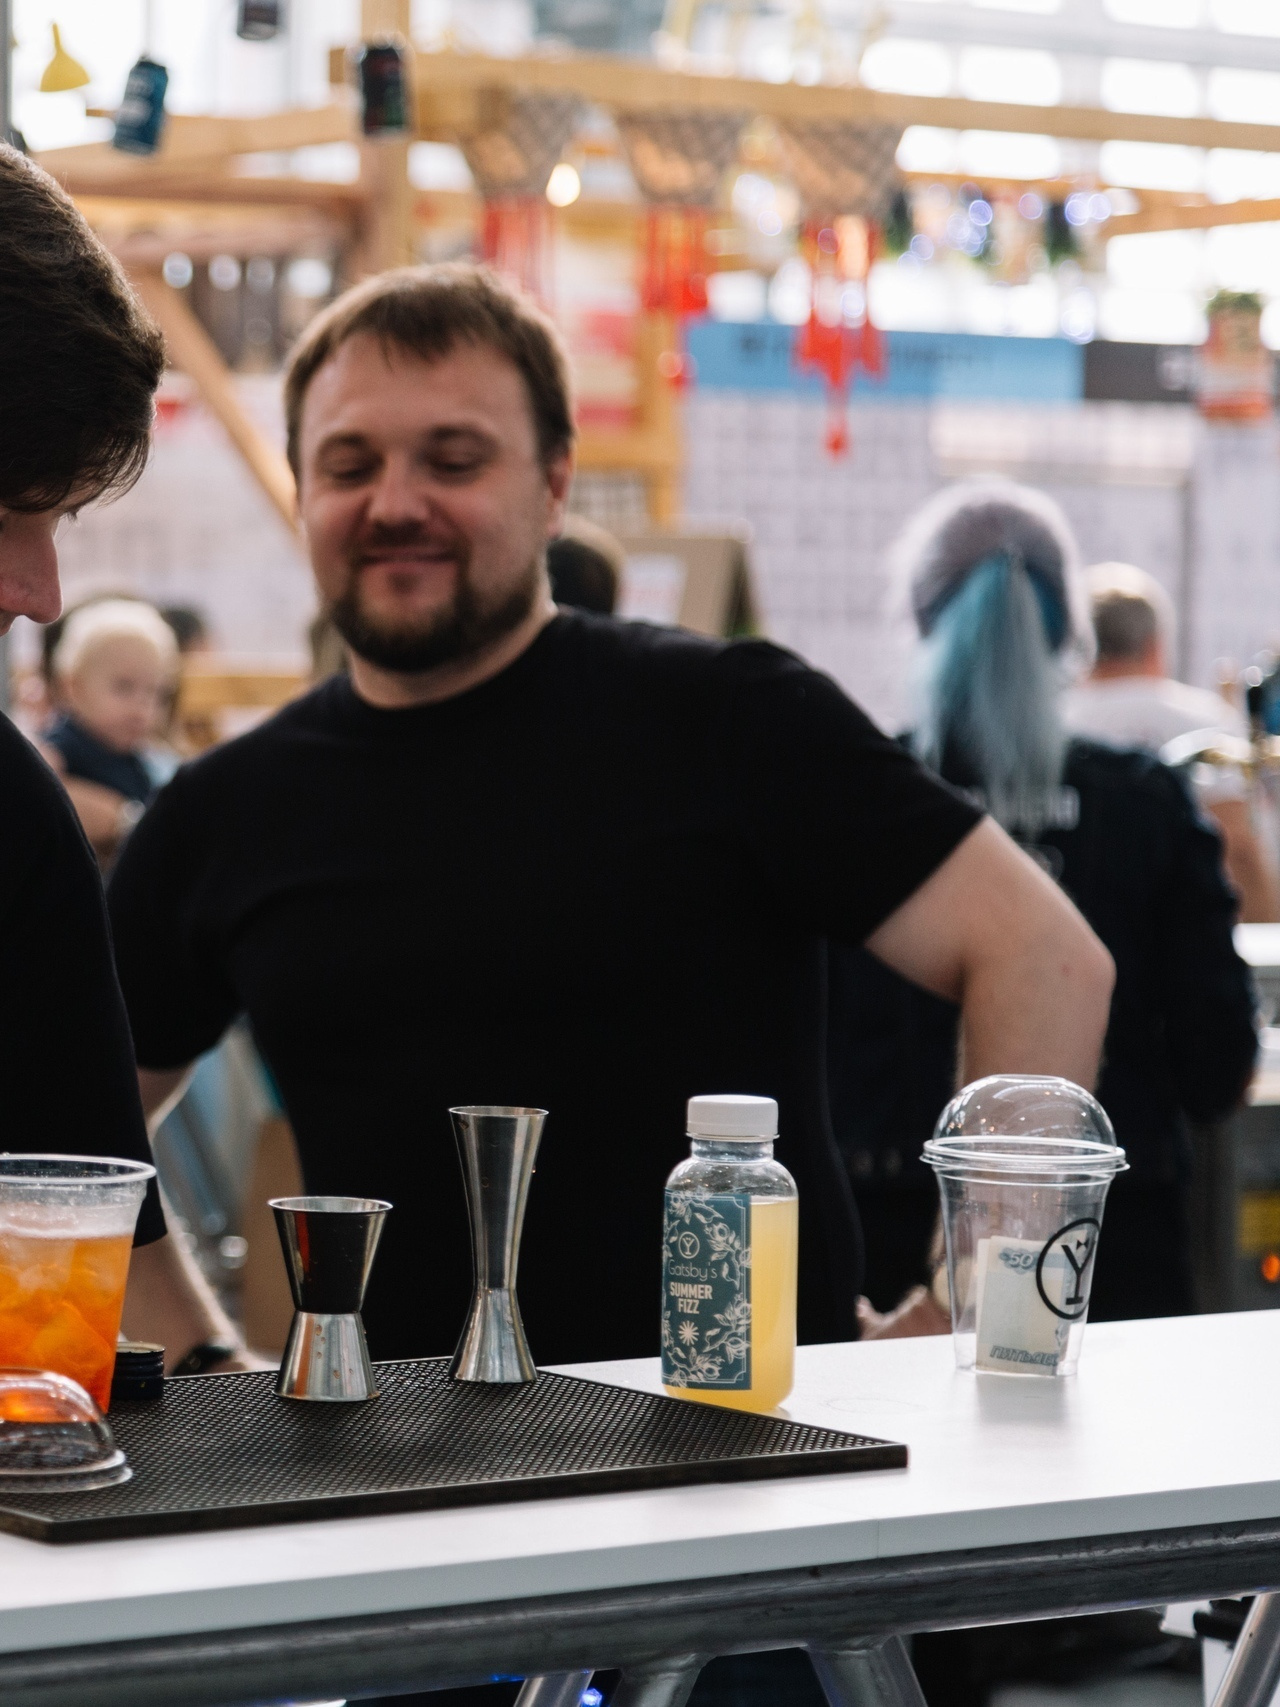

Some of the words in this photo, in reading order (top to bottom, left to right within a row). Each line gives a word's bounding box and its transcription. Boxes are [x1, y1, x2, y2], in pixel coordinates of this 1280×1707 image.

[668, 1258, 718, 1282] Gatsby's
[1008, 1253, 1034, 1270] 50
[670, 1281, 713, 1300] SUMMER
[678, 1298, 700, 1315] FIZZ
